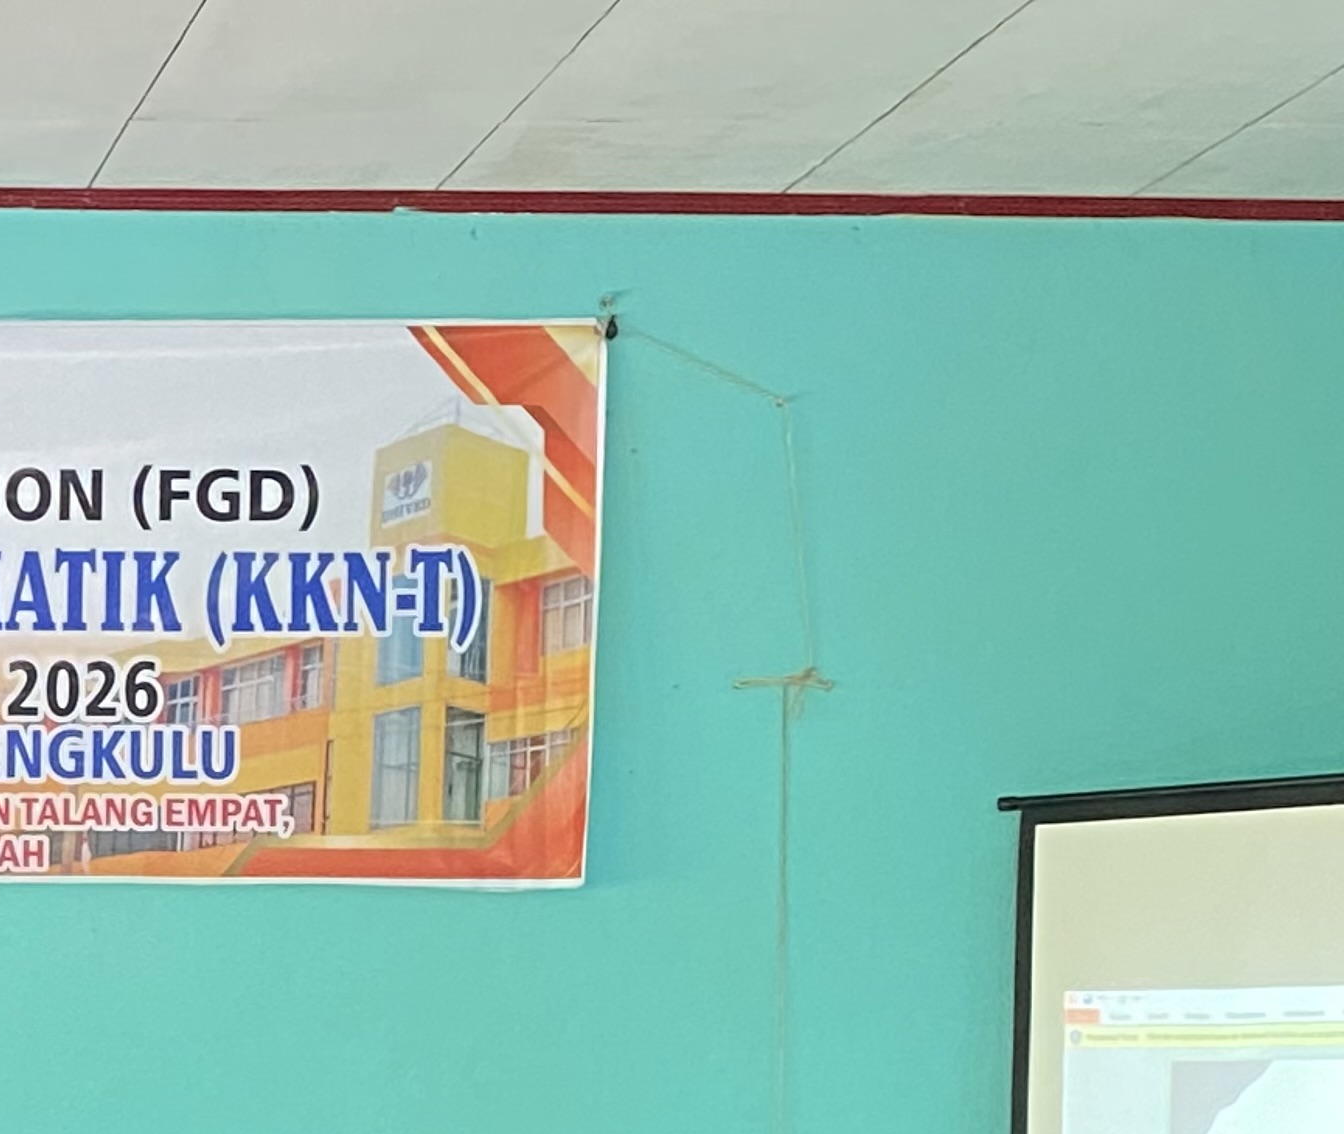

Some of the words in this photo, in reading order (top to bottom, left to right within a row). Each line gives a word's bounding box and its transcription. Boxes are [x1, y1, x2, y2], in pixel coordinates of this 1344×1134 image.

[132, 464, 321, 532] (FGD)
[206, 548, 478, 648] (KKN-T)
[7, 660, 160, 718] 2026
[20, 796, 154, 828] TALANG
[165, 798, 290, 834] EMPAT,
